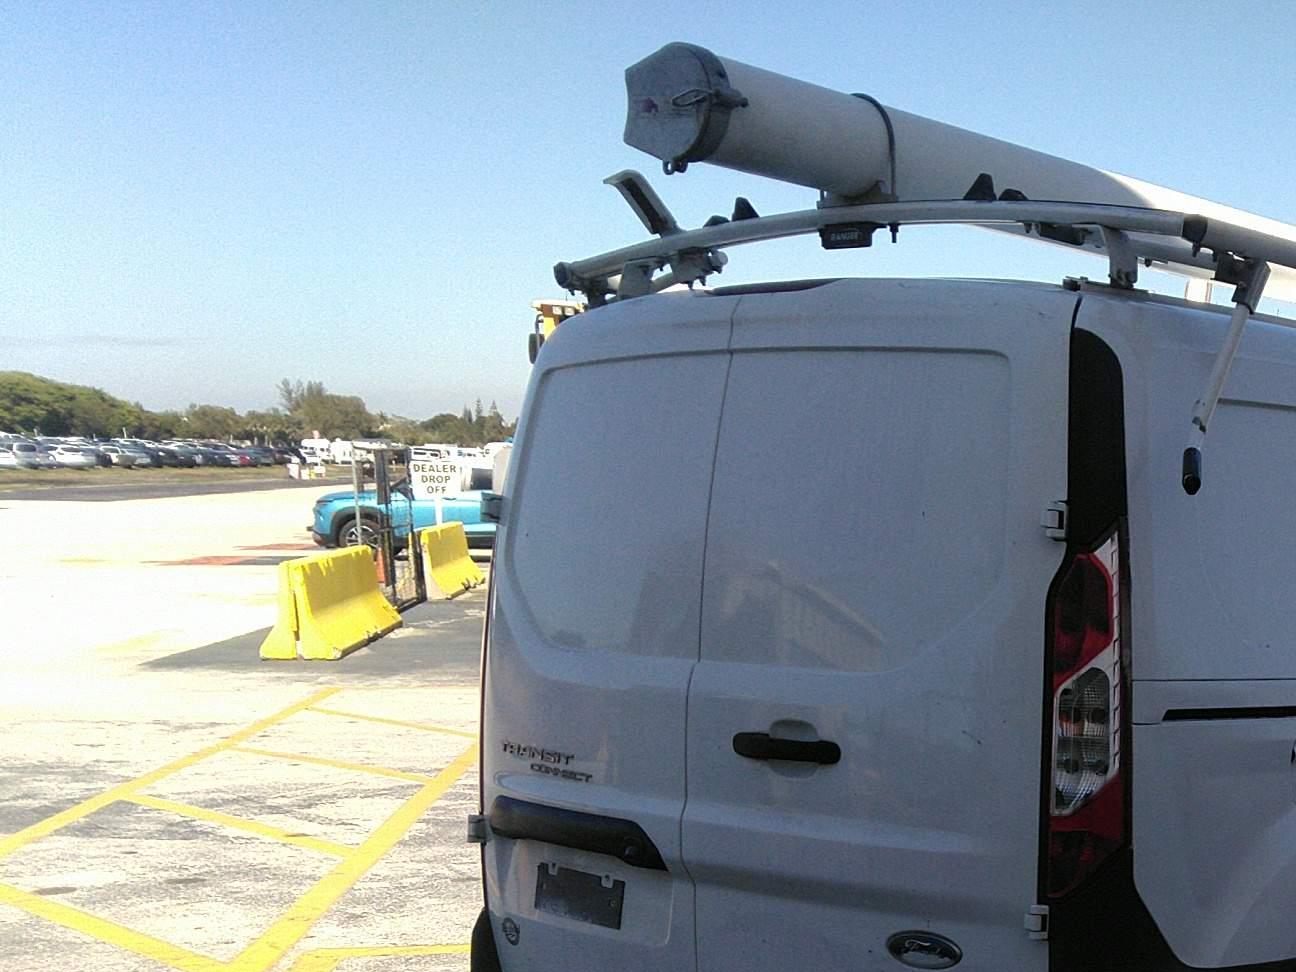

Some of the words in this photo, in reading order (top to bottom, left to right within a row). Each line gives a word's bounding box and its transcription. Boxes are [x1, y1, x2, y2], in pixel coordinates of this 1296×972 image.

[413, 464, 457, 473] DEALER
[421, 475, 451, 484] DROP
[427, 486, 447, 494] OFF
[503, 742, 575, 766] TRANSIT
[530, 763, 593, 783] CONNECT
